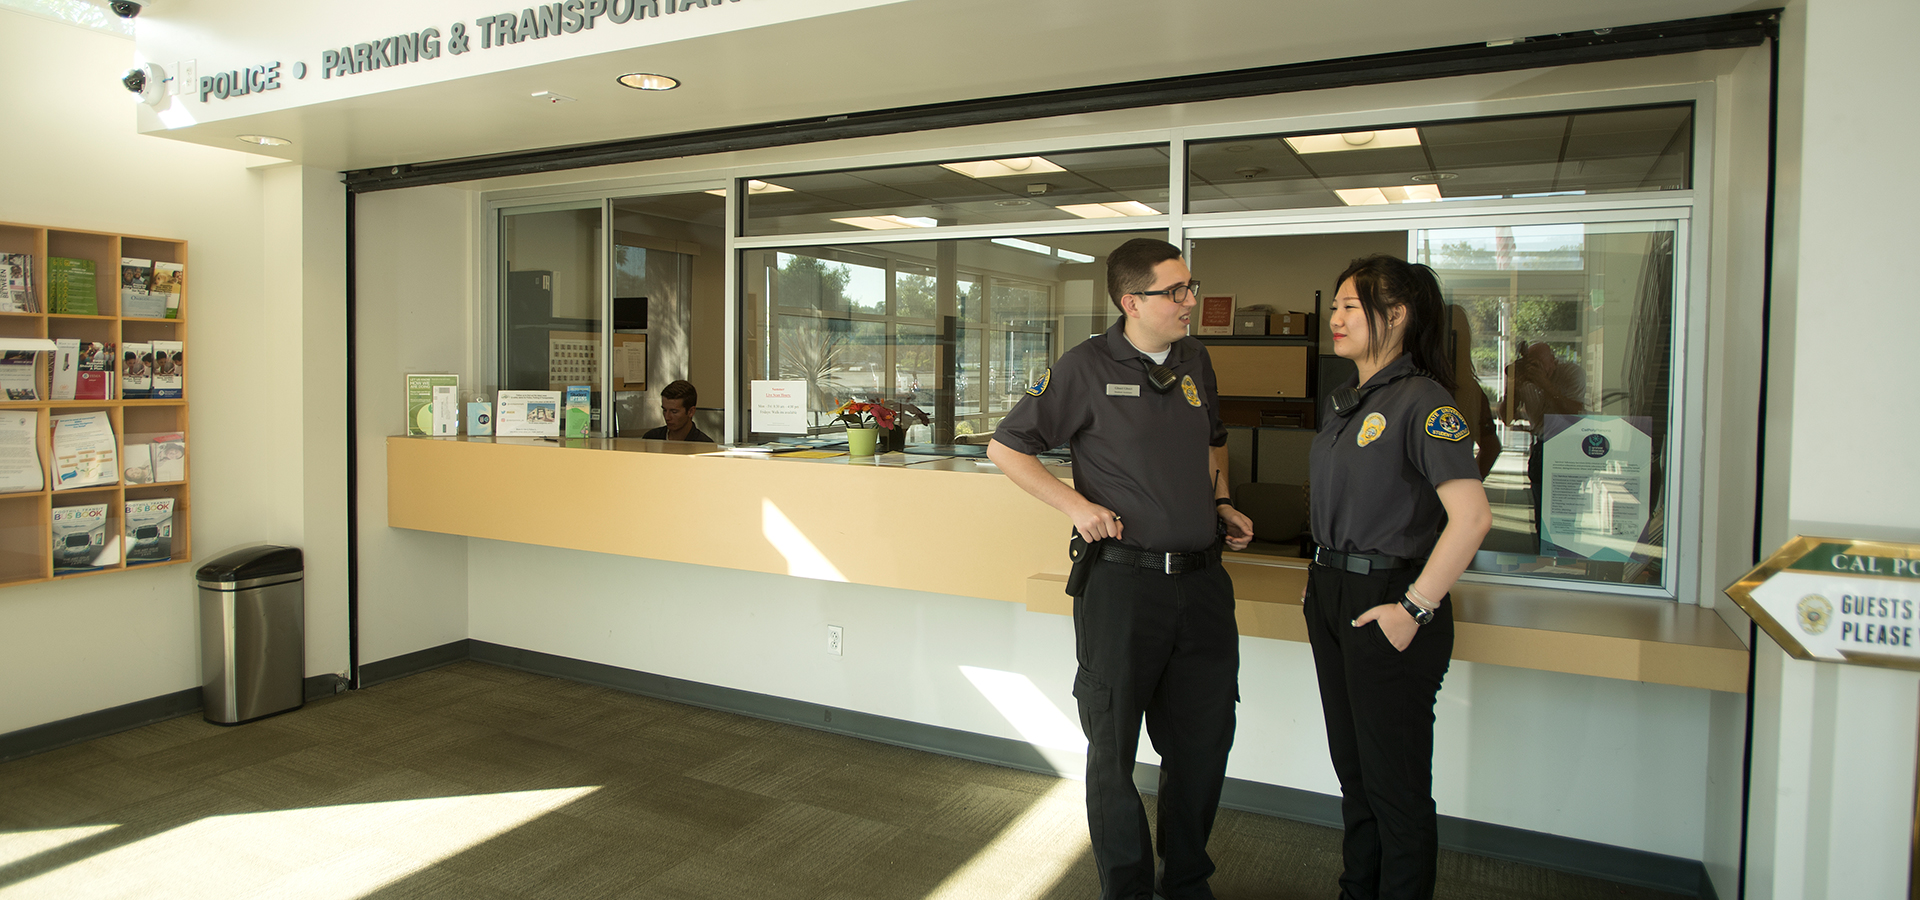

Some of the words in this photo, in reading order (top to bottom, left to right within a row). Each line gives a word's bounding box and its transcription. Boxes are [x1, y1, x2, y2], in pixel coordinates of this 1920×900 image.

[199, 60, 281, 102] POLICE
[321, 27, 441, 79] PARKING
[447, 22, 470, 55] &
[54, 512, 73, 520] BUS
[75, 510, 102, 518] BOOK
[145, 503, 169, 512] BOOK
[1831, 554, 1883, 573] CAL
[1841, 594, 1913, 620] GUESTS
[1841, 621, 1913, 647] PLEASE
